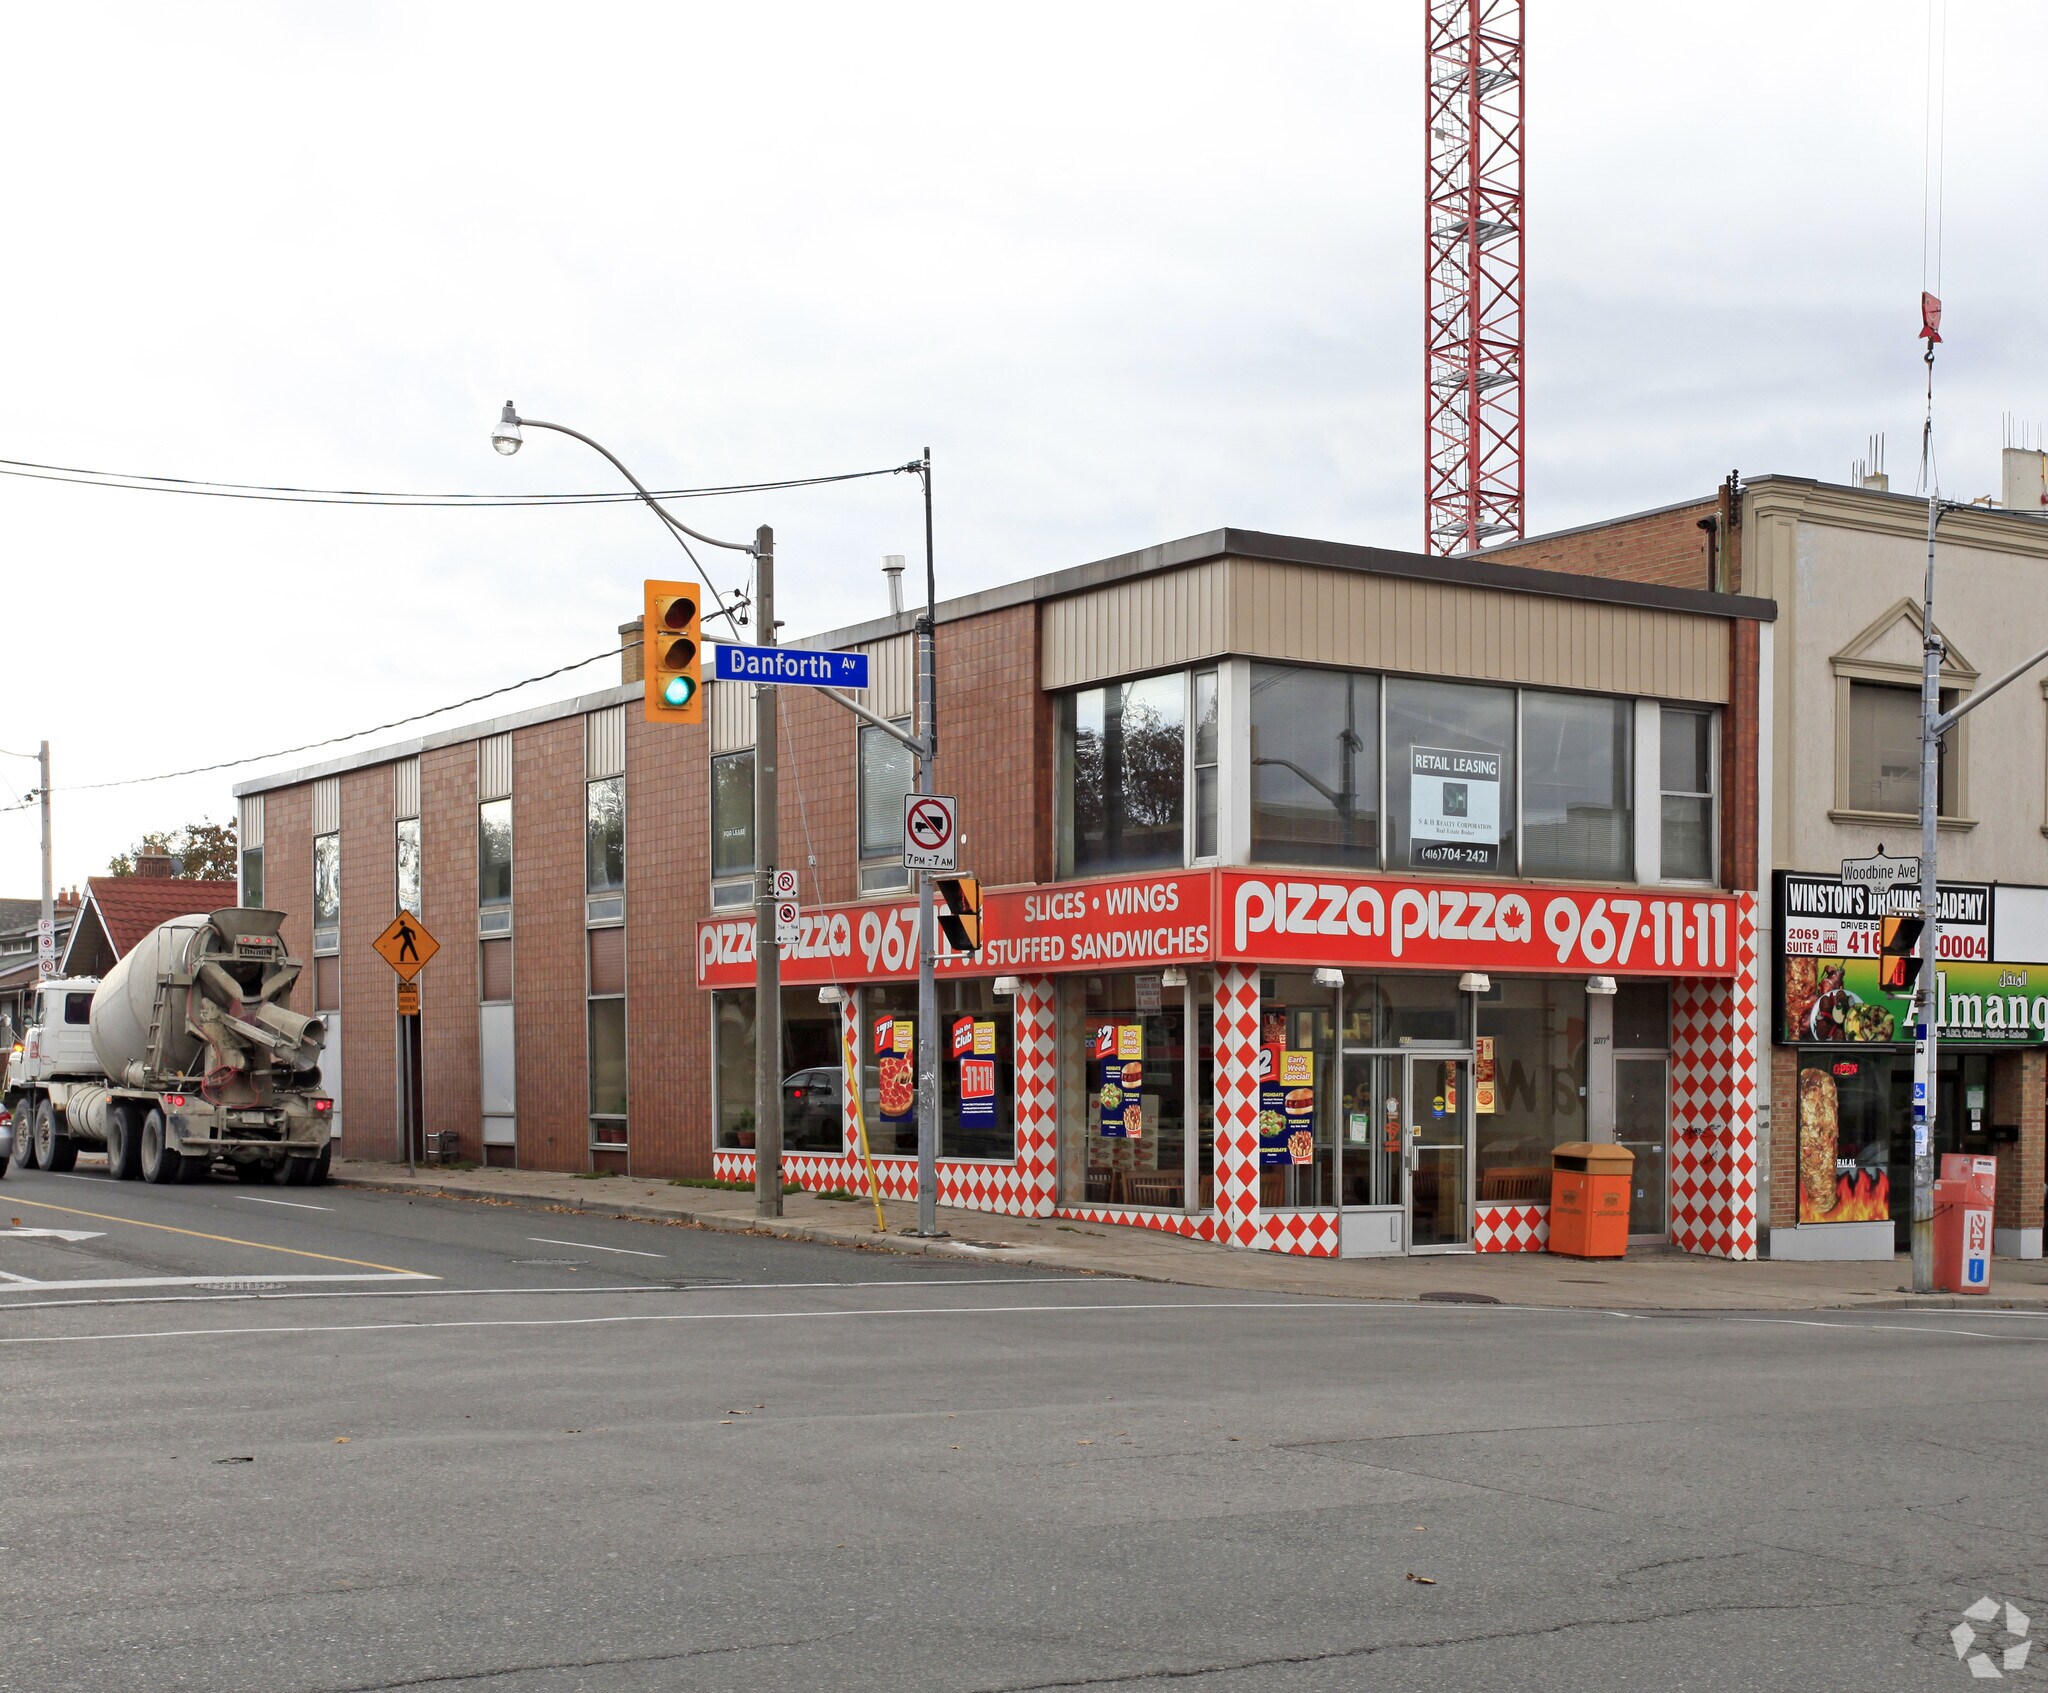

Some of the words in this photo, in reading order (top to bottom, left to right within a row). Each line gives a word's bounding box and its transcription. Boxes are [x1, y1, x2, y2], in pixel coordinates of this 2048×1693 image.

[731, 650, 832, 678] Danforth
[842, 657, 856, 669] Av
[1415, 754, 1450, 771] RETAIL
[1453, 758, 1497, 775] LEASING
[723, 829, 733, 838] FOR
[1844, 865, 1894, 881] Woodbine
[1897, 863, 1916, 878] Ave
[1873, 885, 1886, 893] 954
[1024, 891, 1086, 923] SLICES
[1106, 882, 1179, 916] WINGS
[1789, 883, 1865, 915] WINSTON'S
[1934, 890, 1984, 920] CADEMY
[1841, 921, 1870, 931] DRIVER
[1788, 928, 1819, 940] 2069
[1824, 931, 1837, 941] UPPER
[987, 935, 1065, 966] STUFFED
[1071, 924, 1209, 961] SANDWICHES
[1787, 941, 1813, 953] SUITE
[1816, 943, 1823, 953] 4
[1824, 942, 1837, 953] LEVEL
[955, 1031, 972, 1049] Club
[1287, 1056, 1306, 1064] Early
[1288, 1064, 1307, 1072] Week
[1833, 1063, 1858, 1075] OPEN
[1283, 1073, 1311, 1081] Special!
[1836, 1158, 1857, 1168] HALAL
